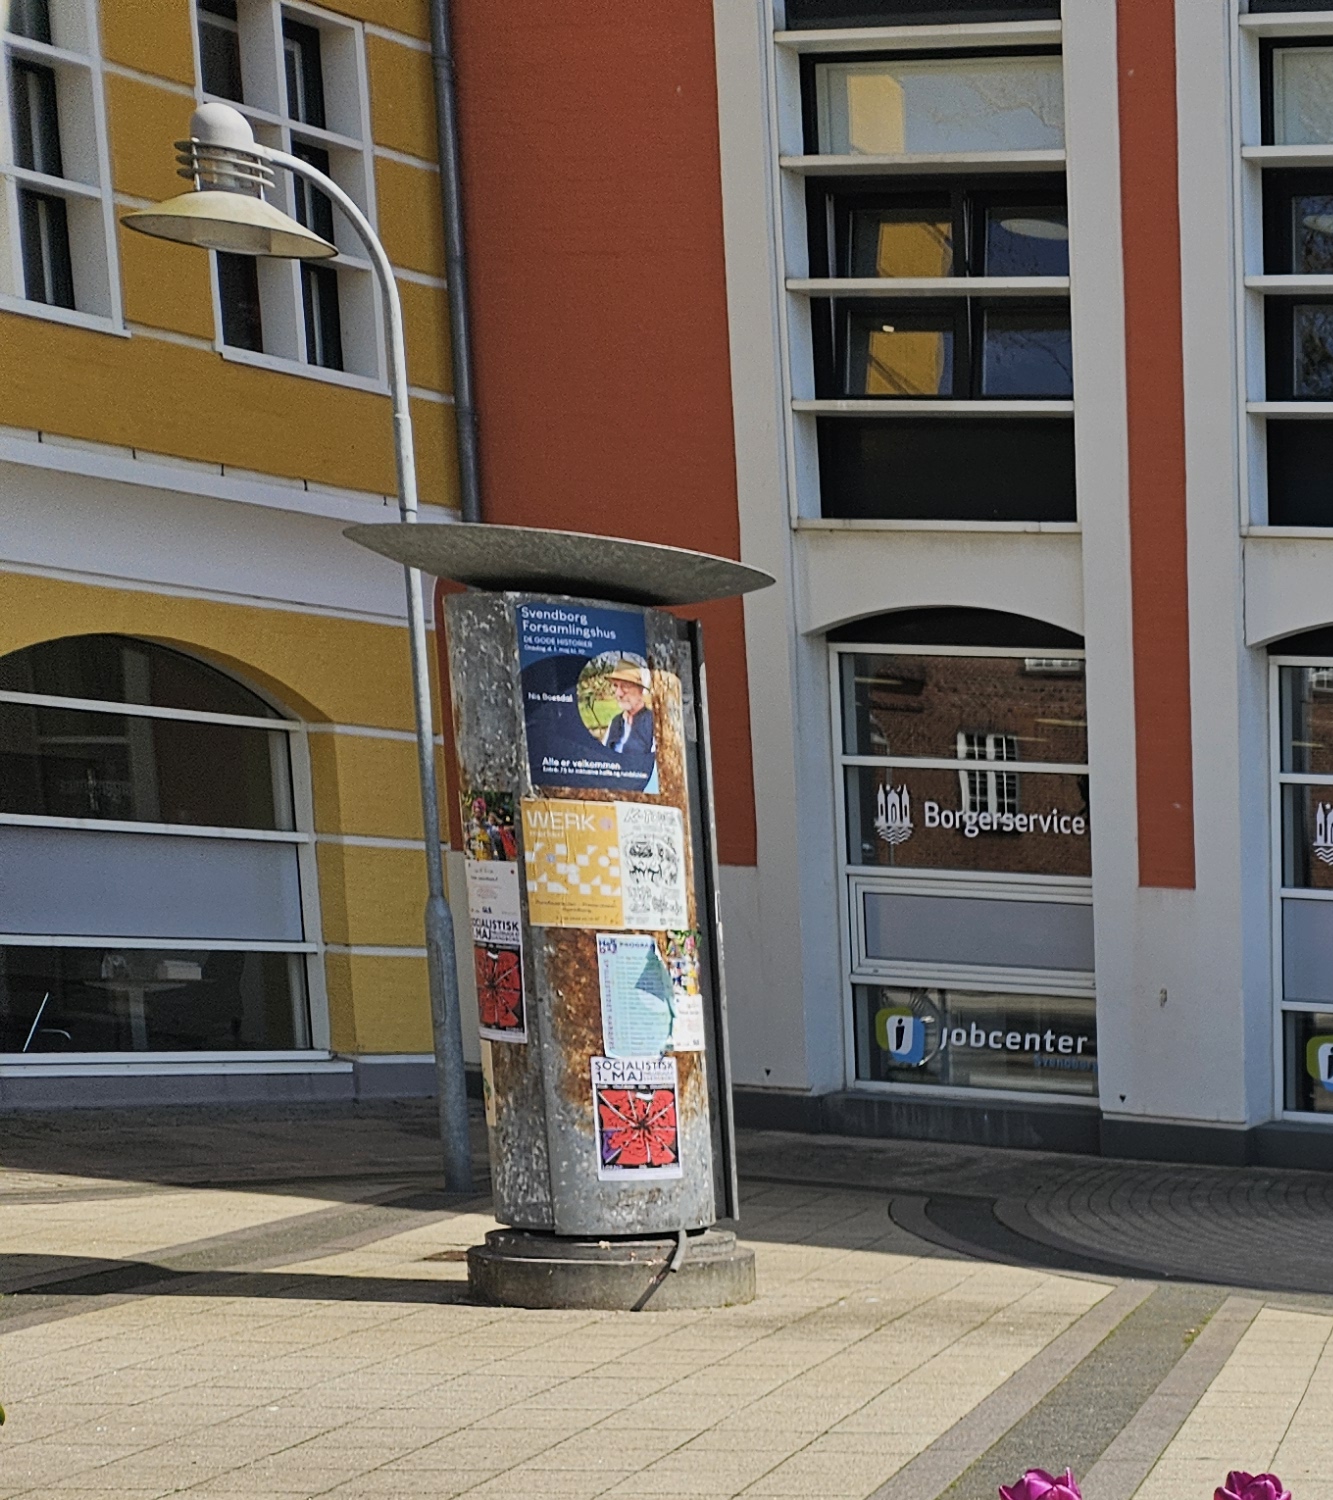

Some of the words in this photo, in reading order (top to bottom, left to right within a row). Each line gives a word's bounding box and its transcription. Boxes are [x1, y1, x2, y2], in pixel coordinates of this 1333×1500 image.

[521, 606, 587, 626] Svendborg
[523, 620, 617, 640] Forsamlingshus
[523, 635, 533, 644] DE
[534, 637, 556, 646] GODE
[556, 638, 593, 648] HISTORIER
[542, 757, 559, 767] Alle
[560, 760, 571, 768] er
[572, 759, 621, 770] velkommen
[526, 810, 596, 832] WERK
[925, 801, 1085, 838] Borgerservice
[940, 1021, 1088, 1054] jobcenter
[595, 1060, 675, 1071] SOCIALISTISK
[1034, 1052, 1098, 1074] Svendborg
[596, 1071, 608, 1081] 1.
[612, 1071, 643, 1081] MAJ
